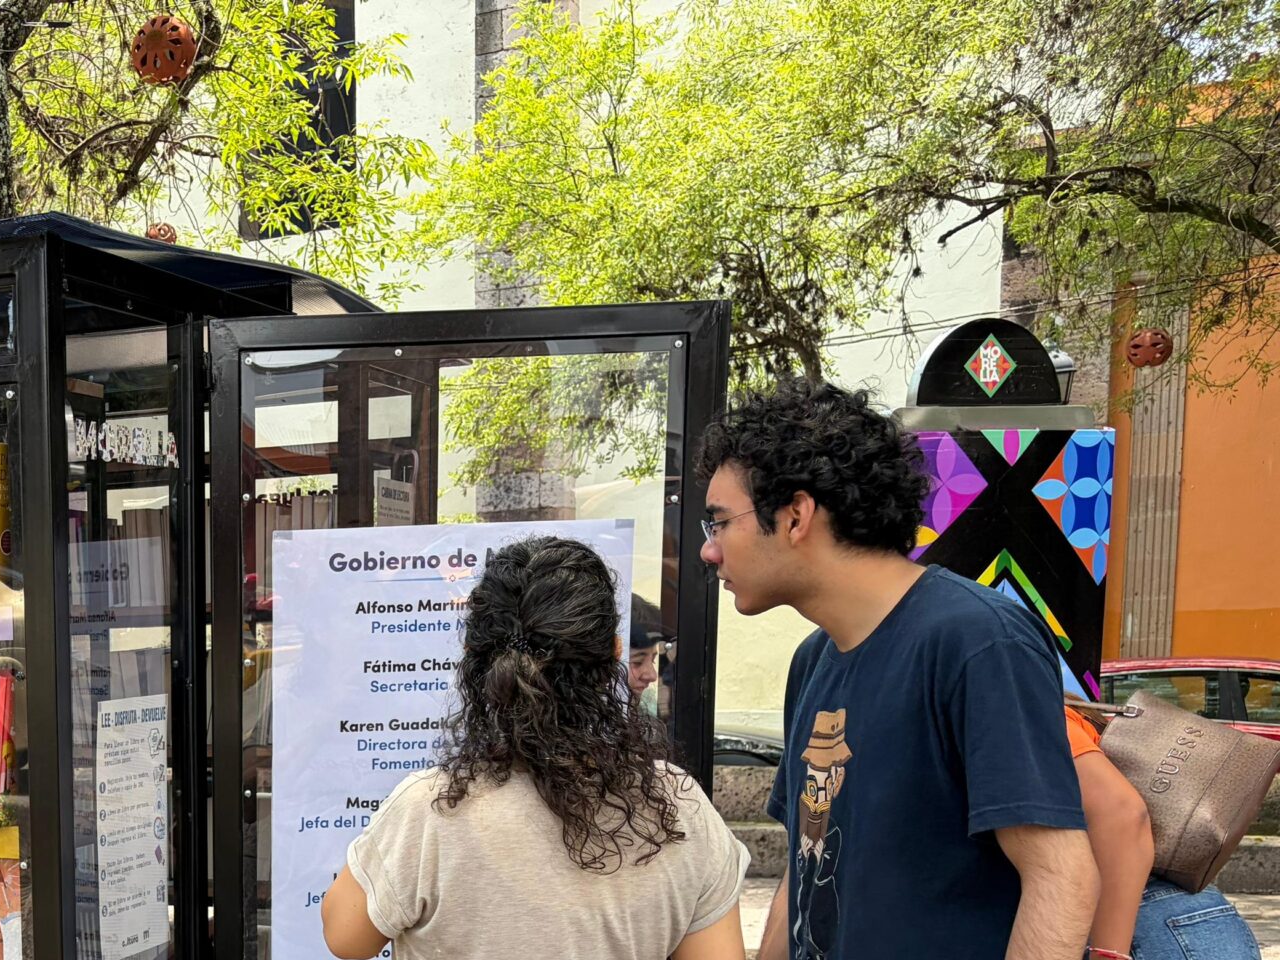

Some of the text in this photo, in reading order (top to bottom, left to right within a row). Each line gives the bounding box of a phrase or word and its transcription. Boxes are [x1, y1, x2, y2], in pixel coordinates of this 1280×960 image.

[980, 346, 1002, 359] MO
[981, 358, 999, 371] RE
[979, 369, 1000, 383] LIA
[328, 550, 440, 573] Gobierno
[448, 547, 477, 568] de
[355, 598, 469, 616] Alfonso Martín
[371, 618, 451, 635] Presidente
[363, 656, 460, 673] Fátima Cháv
[370, 679, 449, 694] Secretaria
[101, 706, 166, 728] LEE DISFRUTA DEVUELVE
[339, 717, 444, 733] Karen Guadal
[357, 737, 428, 751] Directora
[371, 755, 435, 770] Fomento
[1149, 724, 1205, 794] GUESS
[346, 796, 384, 812] Mag
[298, 815, 329, 832] Jefa
[333, 815, 357, 829] del
[305, 891, 324, 907] Jef
